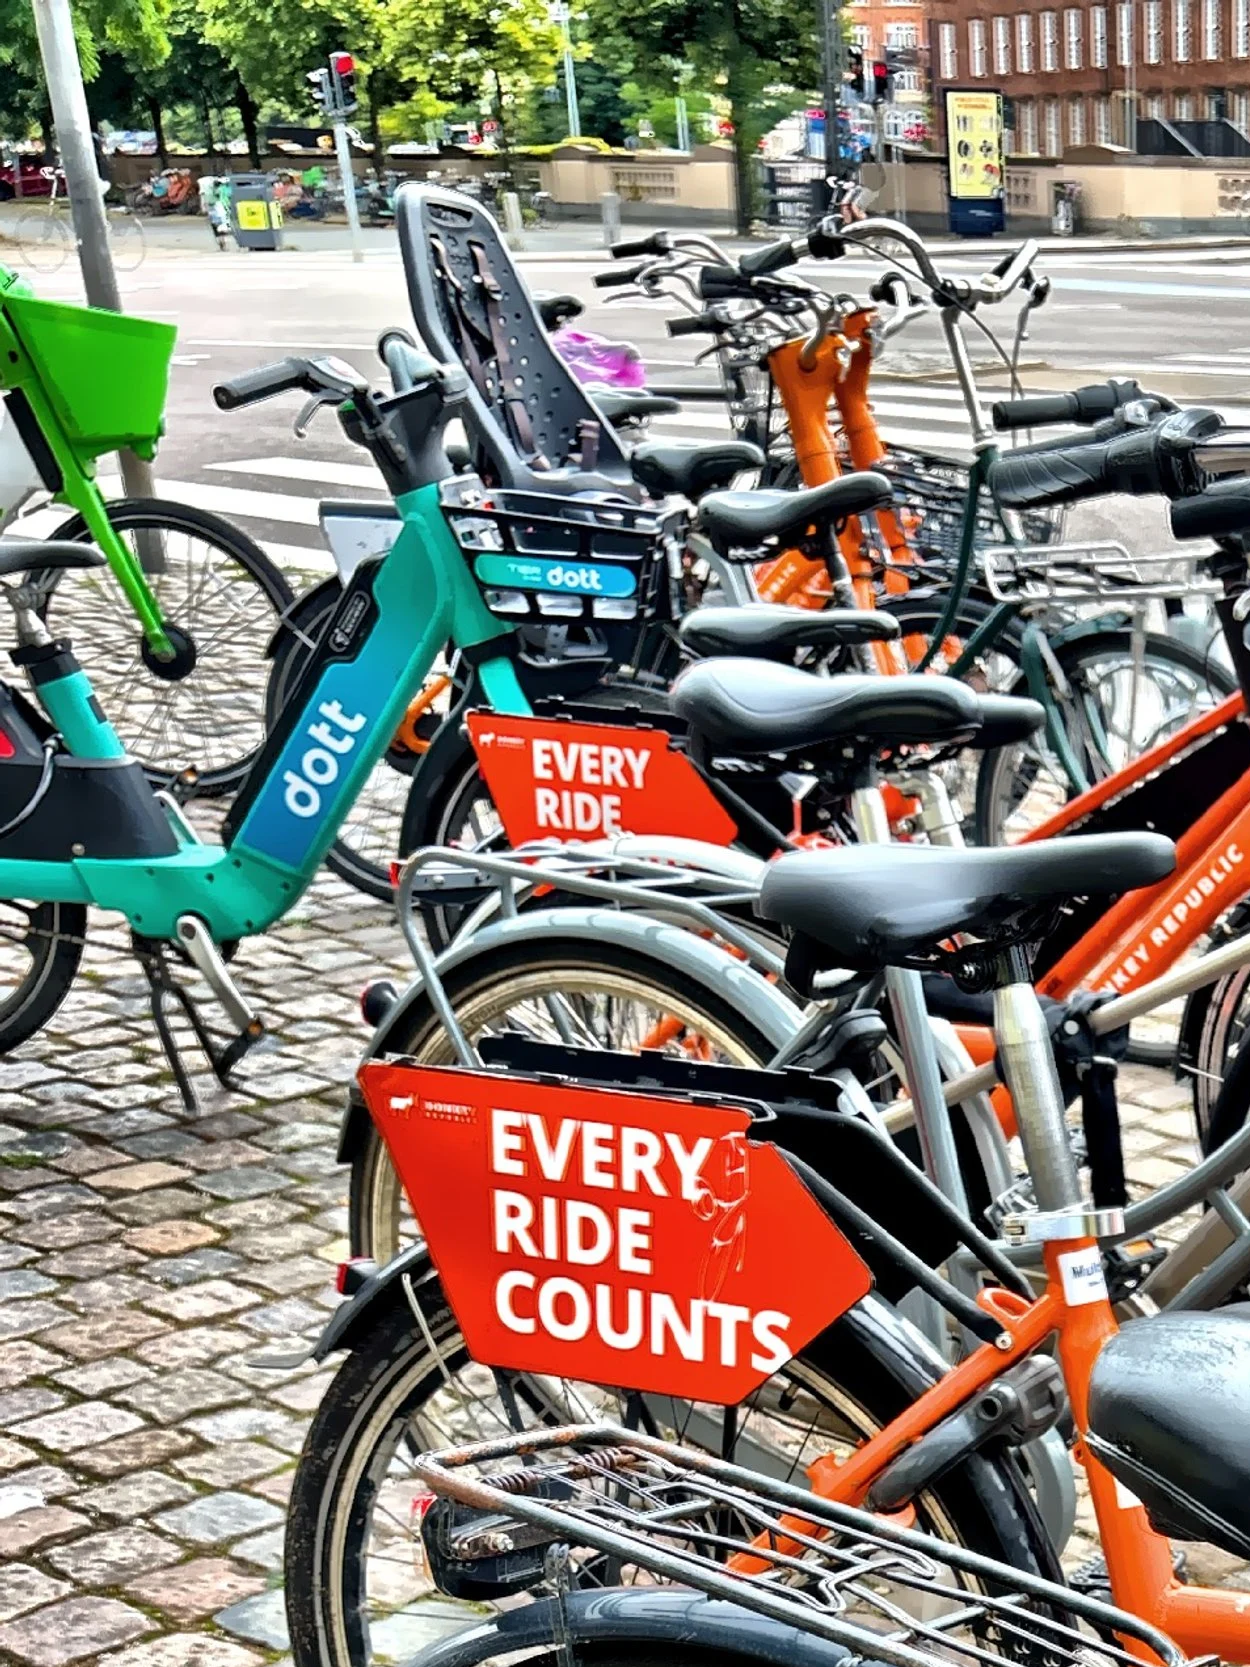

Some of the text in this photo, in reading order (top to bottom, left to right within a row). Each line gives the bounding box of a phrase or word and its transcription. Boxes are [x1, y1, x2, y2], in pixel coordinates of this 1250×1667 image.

[547, 566, 602, 590] dott
[283, 698, 367, 818] dott
[531, 739, 651, 789] EVERY
[536, 789, 621, 833] RIDE
[1150, 843, 1244, 948] REPUBLIC
[491, 1108, 714, 1202] EVERY
[493, 1188, 653, 1276] RIDE
[495, 1270, 792, 1374] COUNTS
